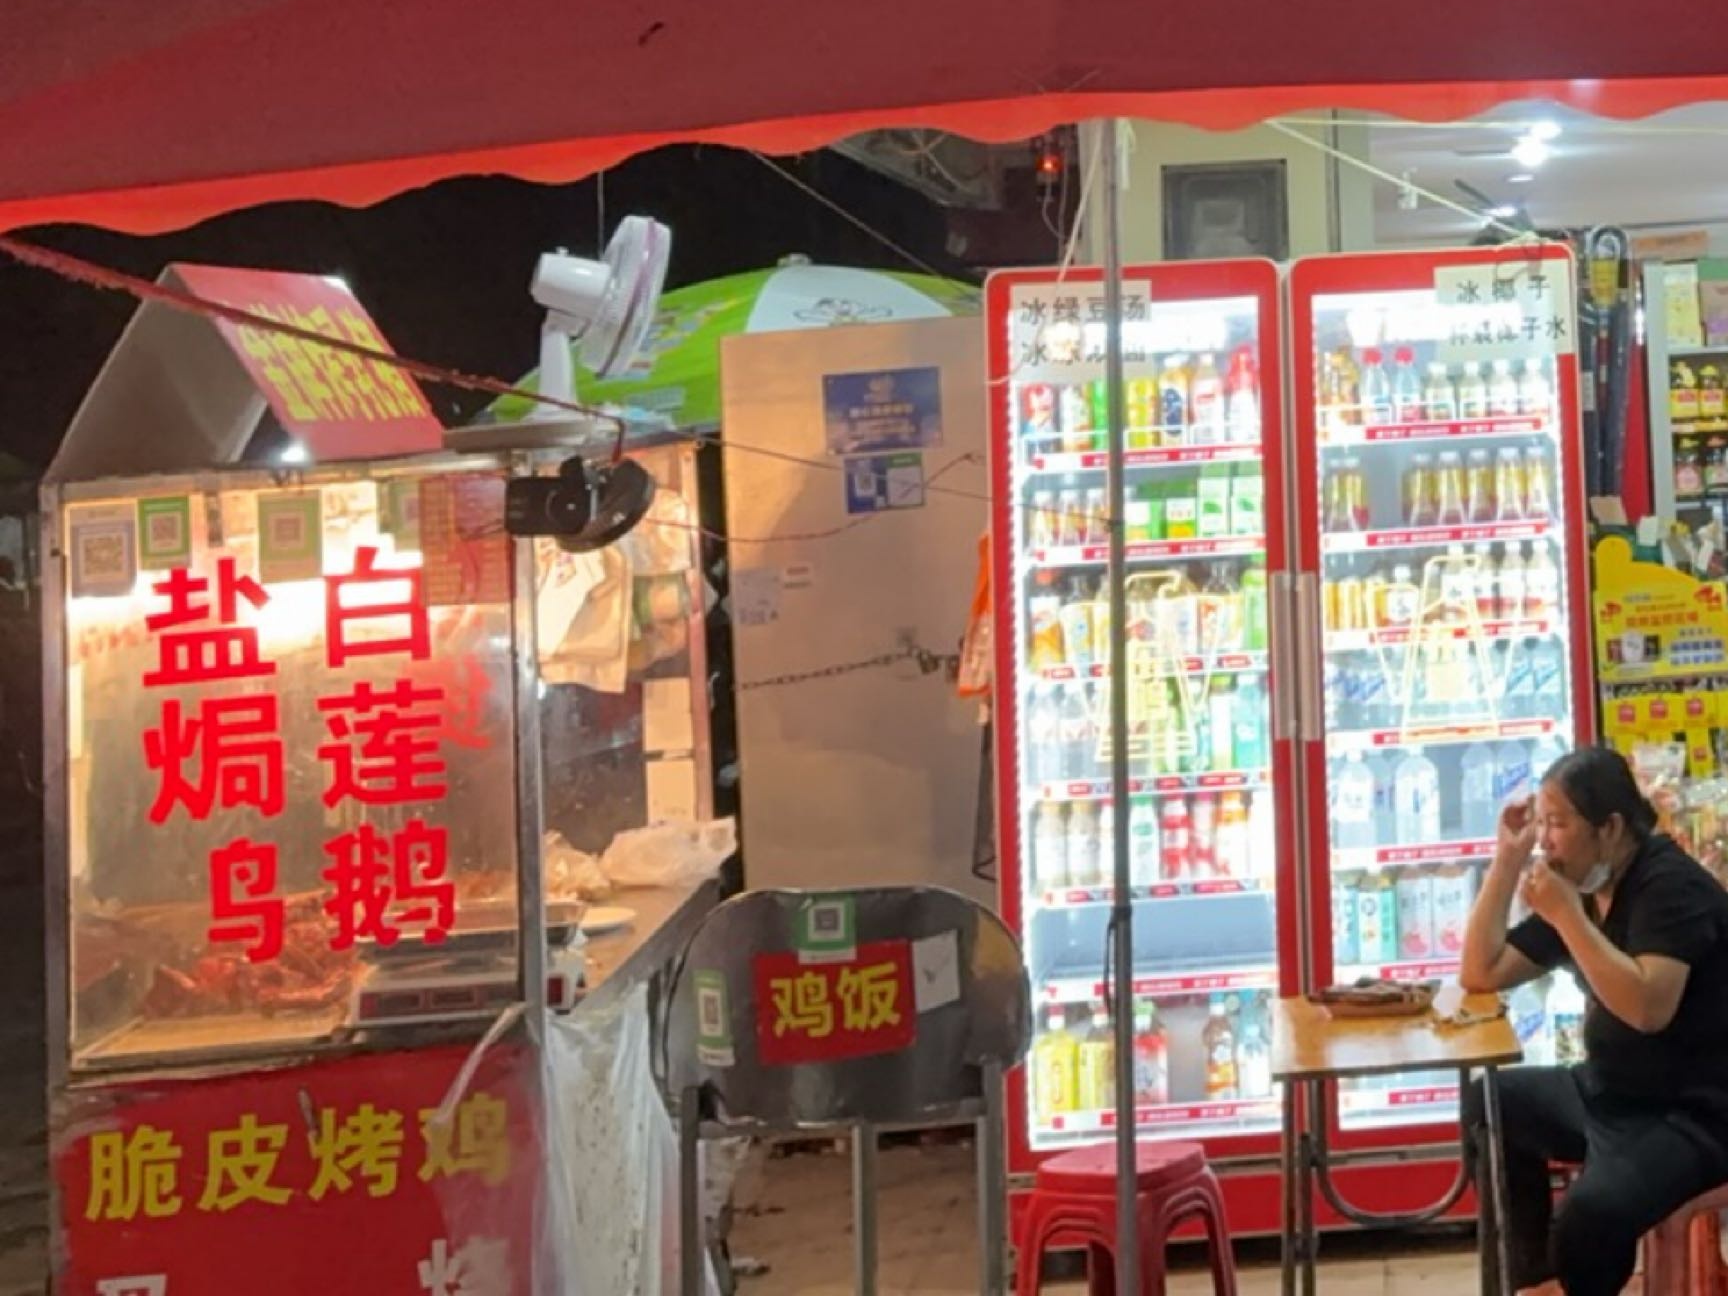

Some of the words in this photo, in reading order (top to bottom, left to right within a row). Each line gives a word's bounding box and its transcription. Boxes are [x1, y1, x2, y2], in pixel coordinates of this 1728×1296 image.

[317, 546, 457, 950] 白莲鹅
[769, 962, 901, 1039] 鸡饭
[85, 1094, 512, 1221] 脆皮烤鸡
